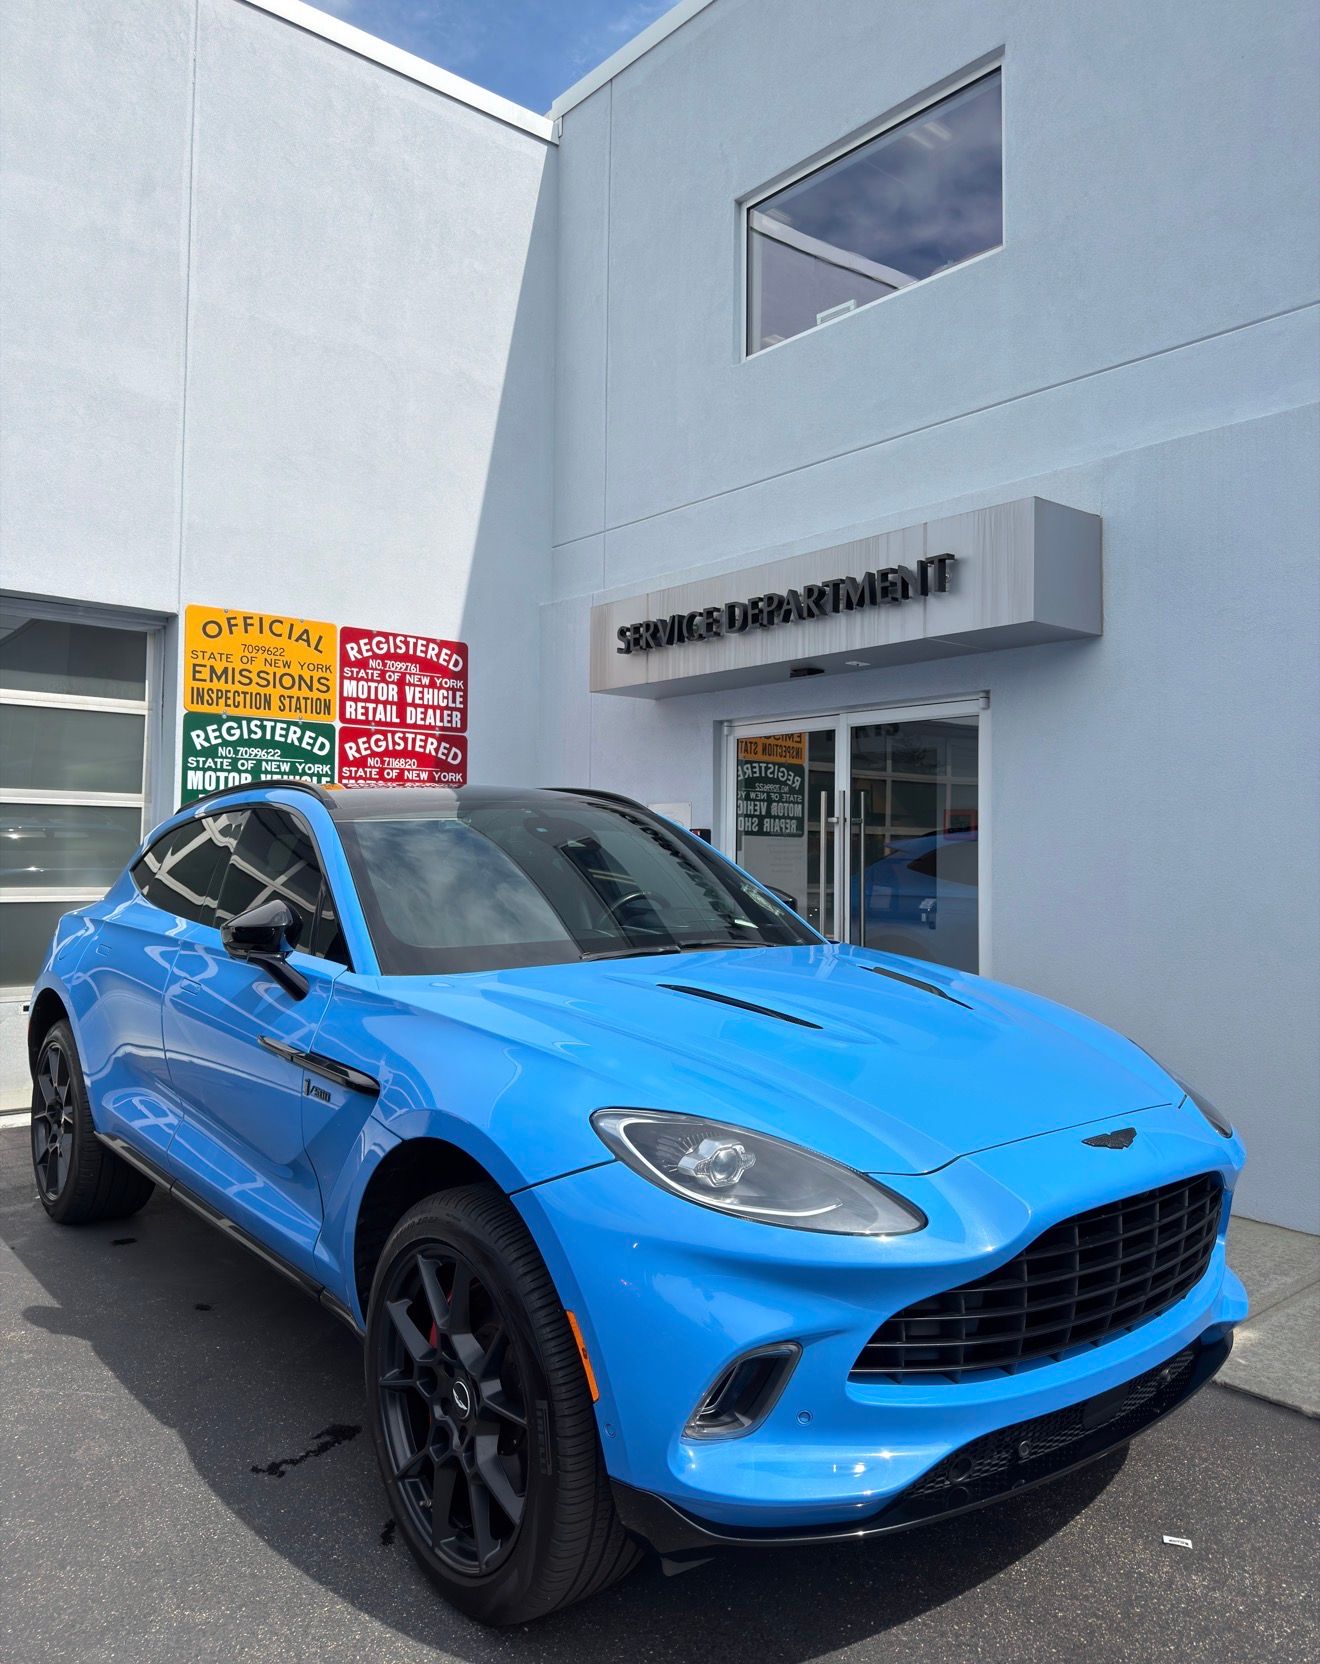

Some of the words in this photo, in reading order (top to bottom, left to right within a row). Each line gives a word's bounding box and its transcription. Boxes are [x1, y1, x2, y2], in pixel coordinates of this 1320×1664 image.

[617, 607, 724, 655] SERVICE
[724, 553, 956, 634] DEPARTMENT
[202, 615, 324, 654] OFFICIAL
[190, 650, 234, 664] STATE
[240, 655, 257, 666] OF
[264, 658, 292, 669] NEW
[297, 661, 333, 674] YORK
[241, 643, 286, 657] 7099622
[345, 635, 464, 672] REGISTERED
[191, 663, 331, 694] EMISSIONS
[343, 667, 381, 680] STATE
[386, 671, 402, 682] OF
[405, 674, 430, 686] NEW
[434, 677, 465, 690] YORK
[369, 658, 384, 670] NO.
[385, 660, 420, 673] 7099761
[190, 686, 272, 711] INSPECTION
[278, 695, 331, 716] STATION
[343, 679, 398, 702] MOTOR
[405, 685, 464, 708] VEHICLE
[345, 701, 400, 723] RETAIL
[406, 706, 462, 728] DEALER
[190, 720, 331, 756] REGISTERED
[344, 732, 462, 765] REGISTERED
[187, 757, 232, 769] STATE
[237, 760, 257, 771] OF
[261, 761, 290, 772] NEW
[296, 763, 331, 775] YORK
[218, 746, 236, 758] NO.
[236, 747, 281, 759] 7099622
[367, 757, 382, 768] NO.
[383, 757, 418, 769] 7116820
[342, 767, 379, 778] STATE
[384, 769, 400, 779] OF
[404, 770, 429, 781] NEW
[433, 771, 463, 783] YORK
